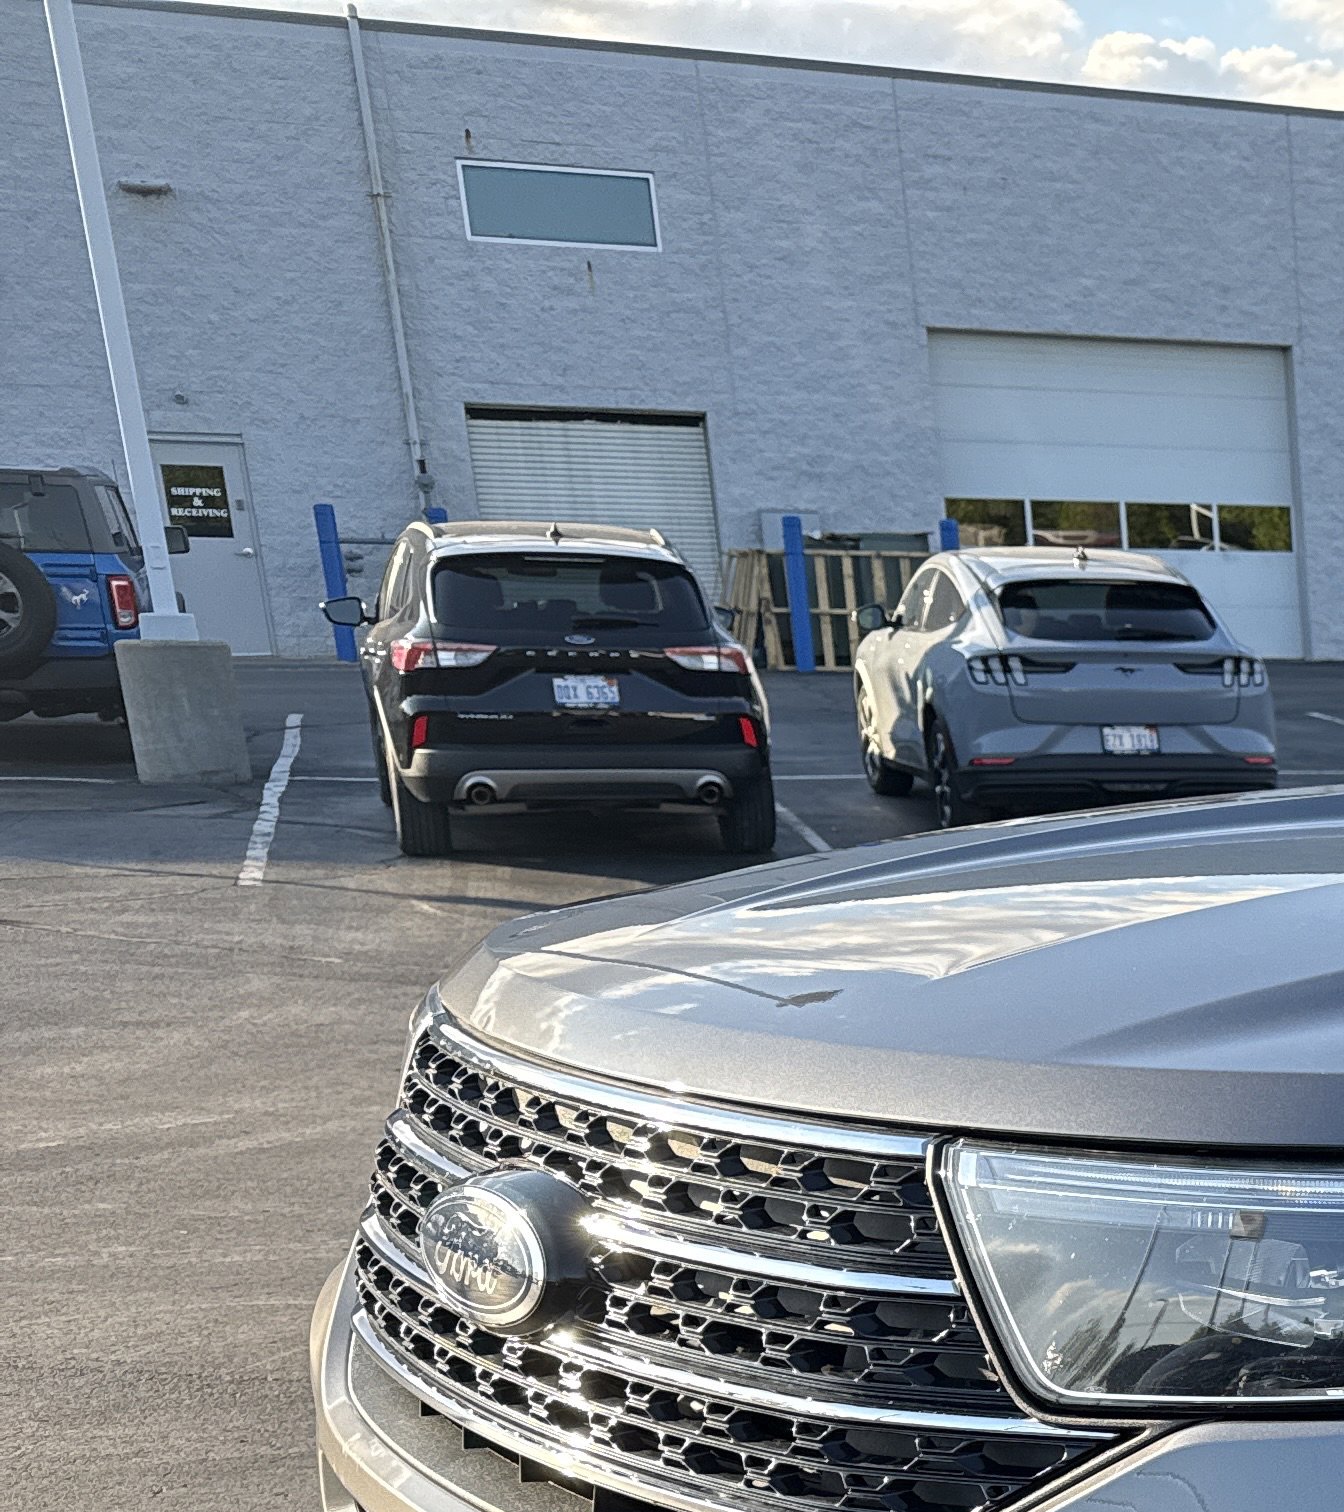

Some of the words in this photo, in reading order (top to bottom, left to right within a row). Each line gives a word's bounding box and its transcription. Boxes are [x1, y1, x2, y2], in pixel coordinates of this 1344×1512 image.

[170, 486, 221, 497] SHIPPING
[192, 496, 205, 507] &
[170, 507, 228, 518] RECEIVING
